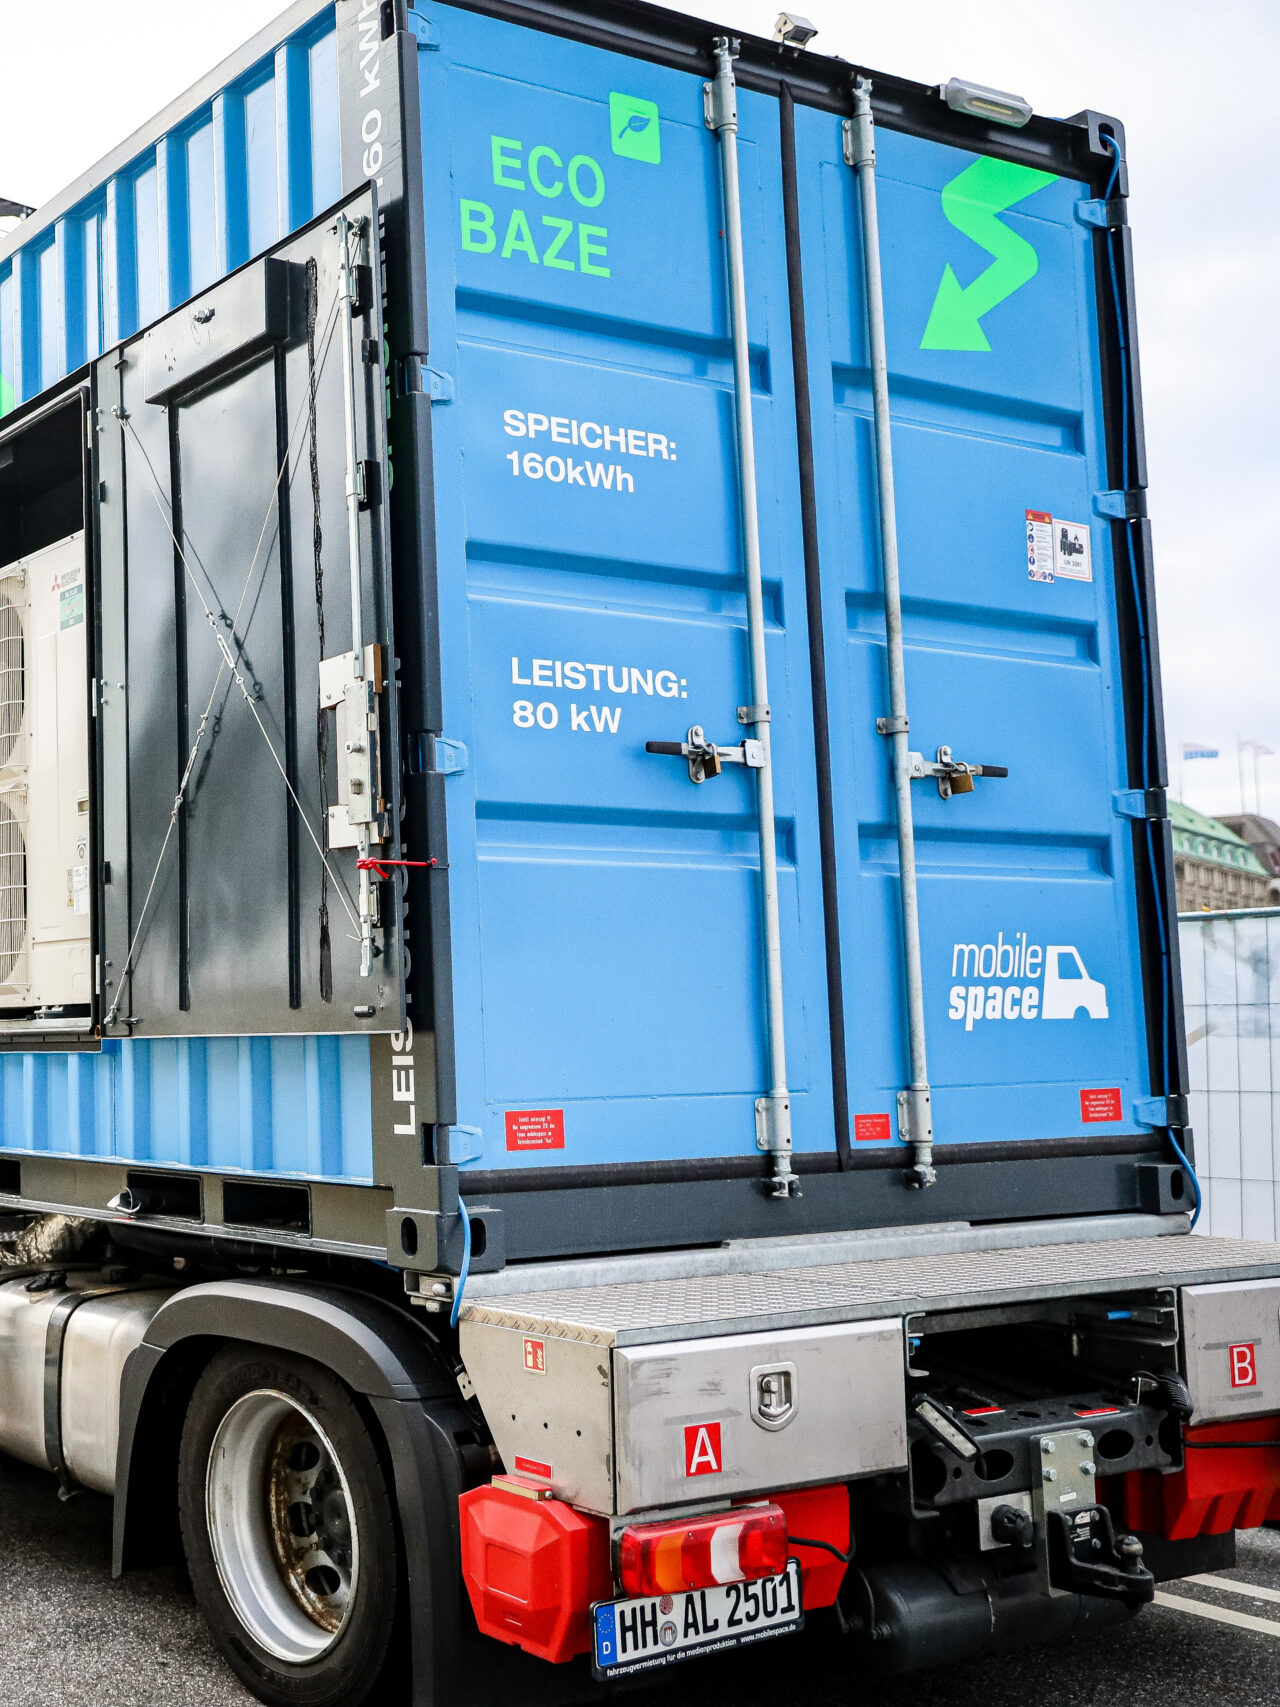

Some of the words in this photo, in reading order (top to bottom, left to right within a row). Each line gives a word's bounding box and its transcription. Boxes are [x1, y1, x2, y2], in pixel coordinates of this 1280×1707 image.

[491, 135, 605, 208] ECO
[459, 199, 611, 278] BAZE
[503, 409, 677, 461] SPEICHER:
[506, 451, 635, 493] 160kWh
[511, 656, 688, 699] LEISTUNG:
[512, 700, 559, 729] 80
[570, 703, 622, 734] kW
[951, 931, 1042, 978] mobile
[948, 985, 1040, 1032] space
[1233, 1346, 1254, 1386] B
[689, 1427, 718, 1474] A
[619, 1602, 659, 1653] HH
[683, 1589, 719, 1639] AL
[725, 1571, 796, 1628] 2501
[602, 1641, 611, 1655] D
[606, 1657, 666, 1677] fahrzeugvermietung
[676, 1650, 686, 1659] die
[686, 1638, 737, 1657] medienproduktion
[740, 1623, 797, 1644] www.mobilespace.de
